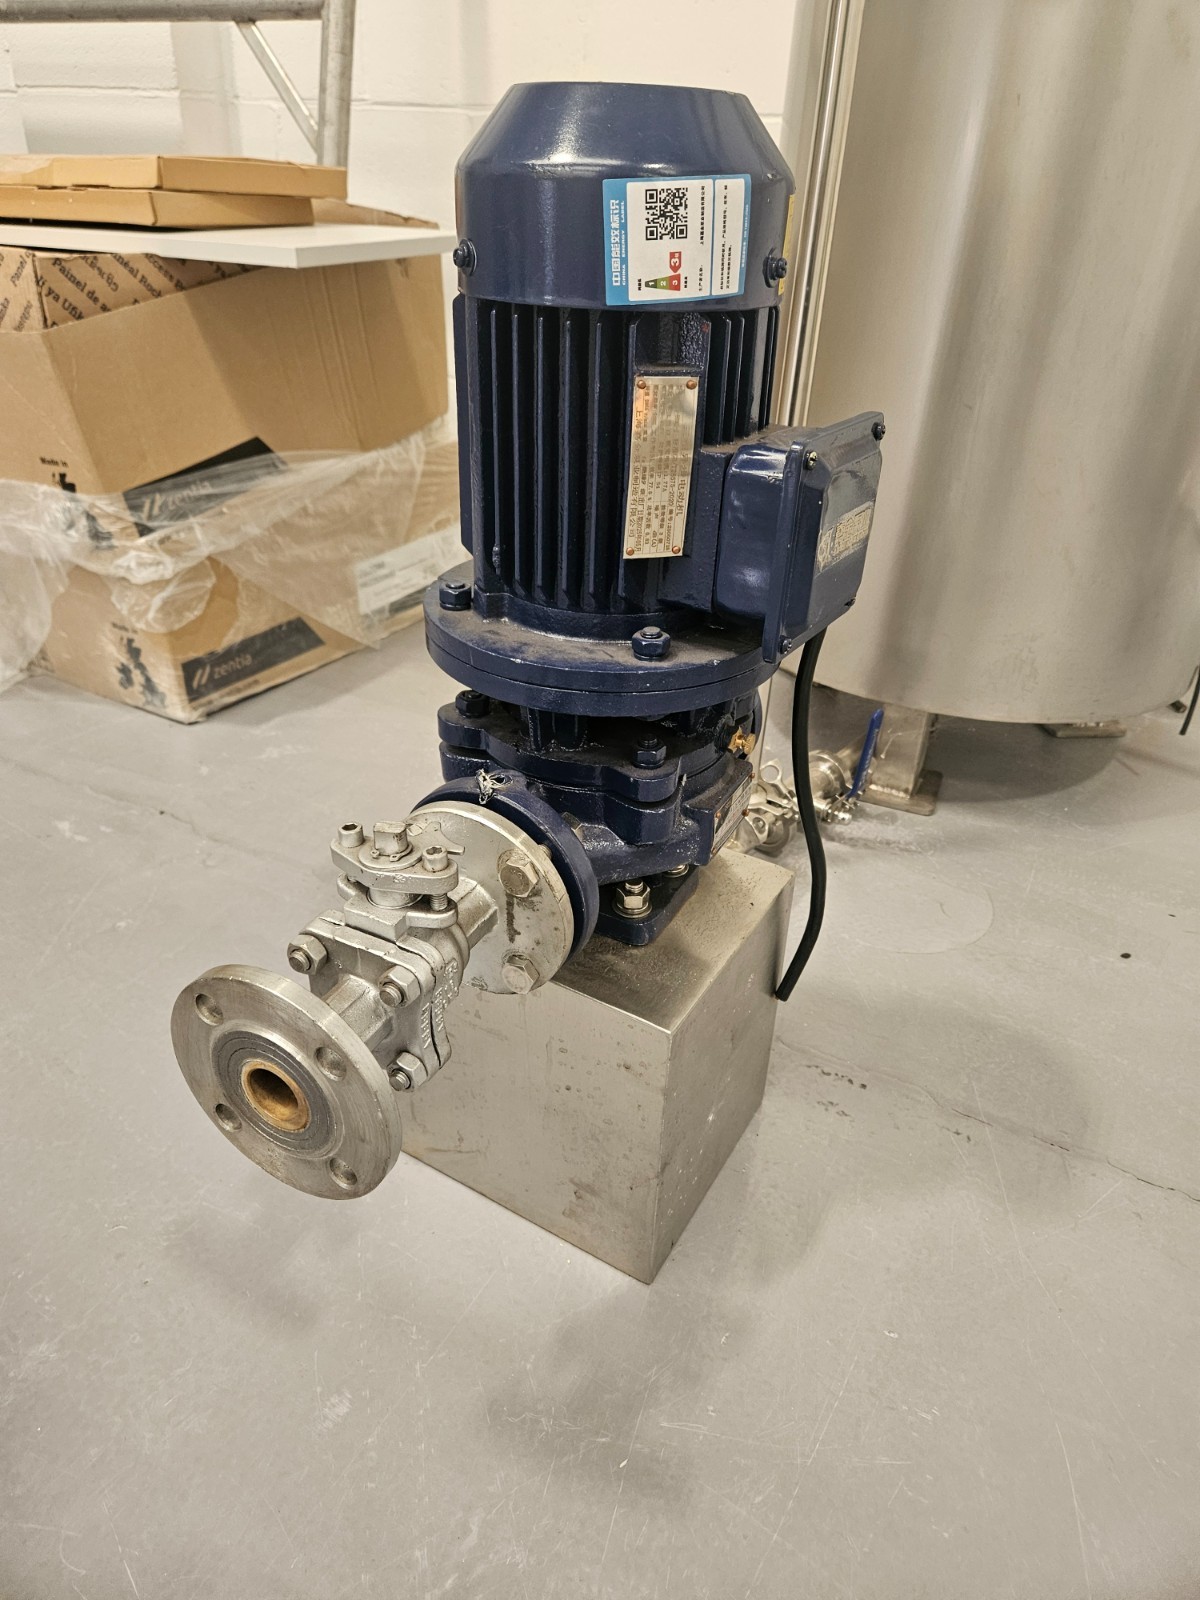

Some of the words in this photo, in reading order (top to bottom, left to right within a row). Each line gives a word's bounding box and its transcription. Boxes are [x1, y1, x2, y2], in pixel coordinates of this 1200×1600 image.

[610, 200, 620, 286] 中国能效标识
[45, 286, 60, 303] ya
[52, 257, 88, 292] Painel
[86, 289, 100, 305] de
[214, 653, 253, 680] zentia
